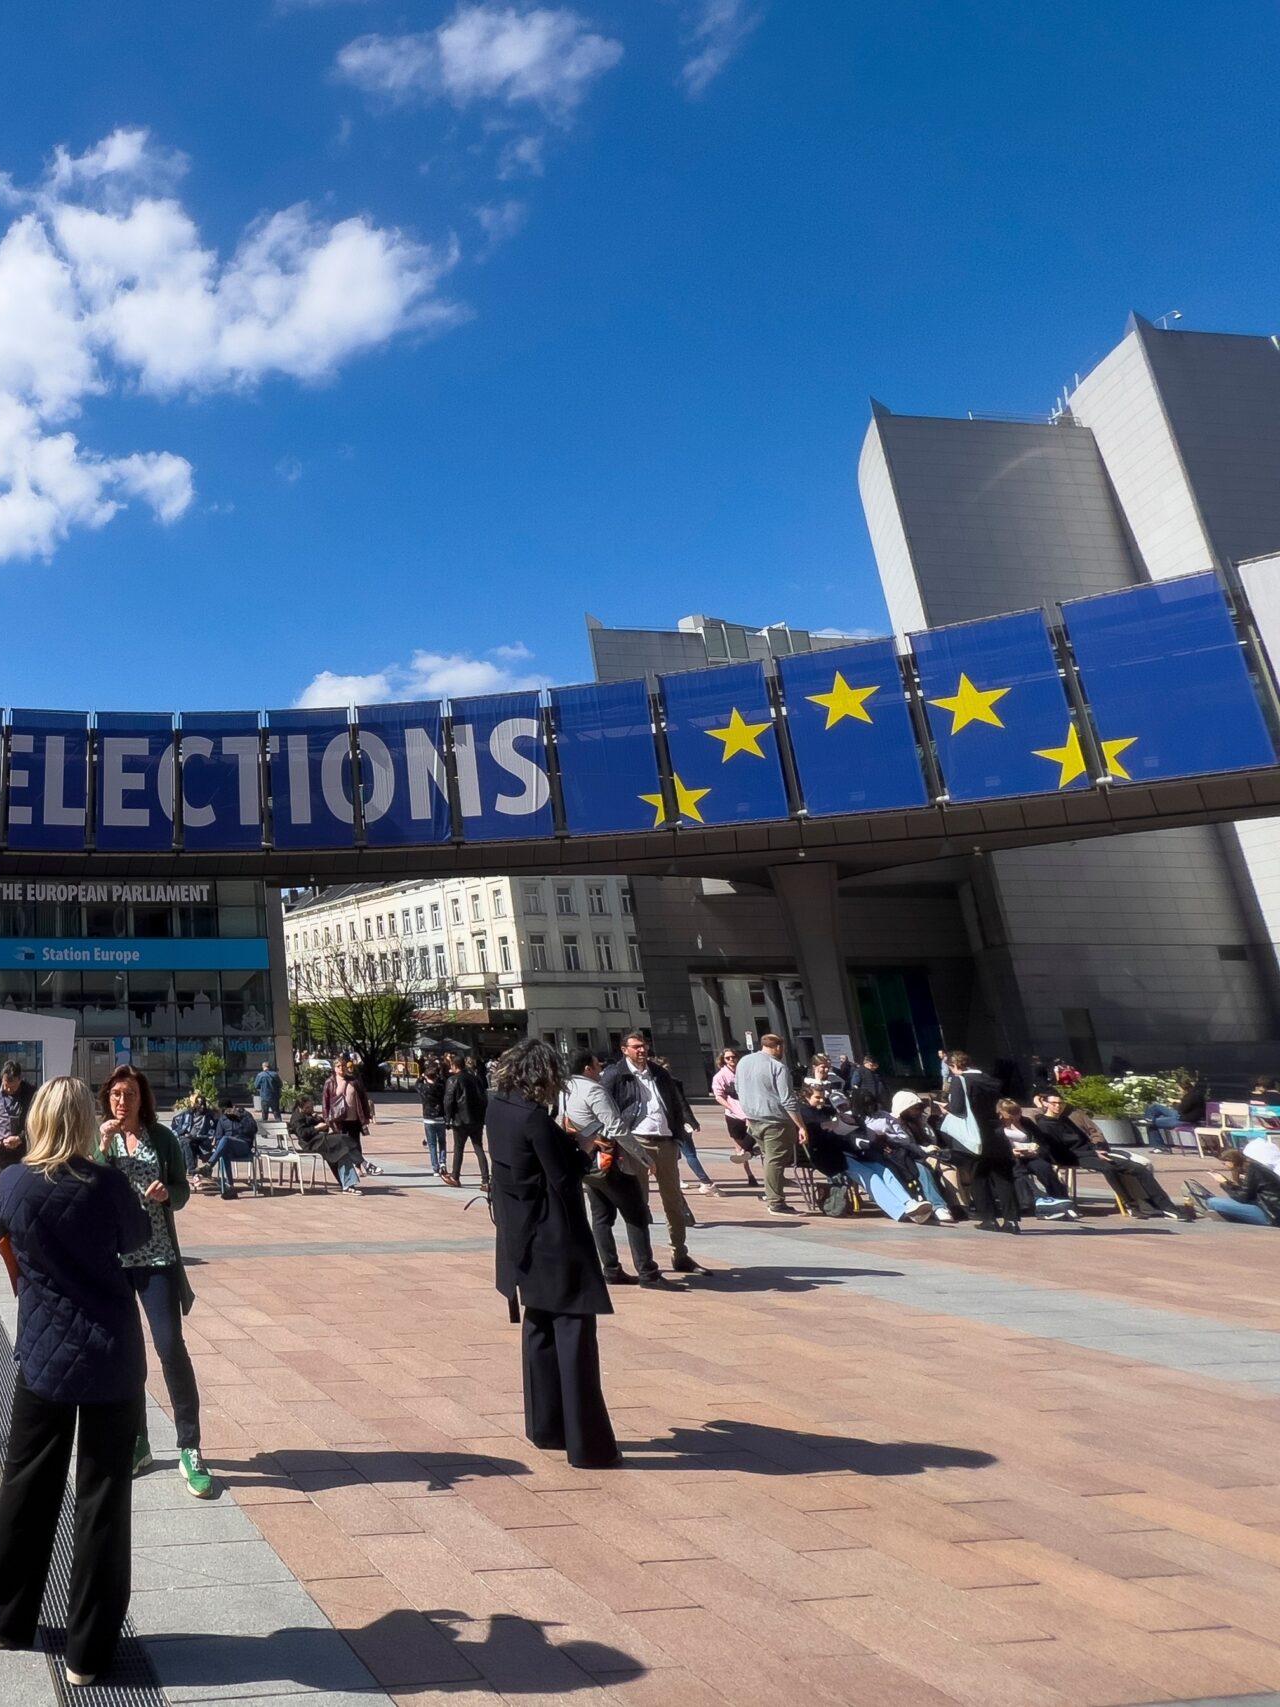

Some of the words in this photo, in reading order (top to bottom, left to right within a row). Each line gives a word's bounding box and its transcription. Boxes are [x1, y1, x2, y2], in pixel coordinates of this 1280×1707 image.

[26, 884, 108, 902] EUROPEAN
[112, 884, 210, 902] PARLIAMENT
[42, 947, 91, 961] Station
[94, 947, 140, 965] Europe
